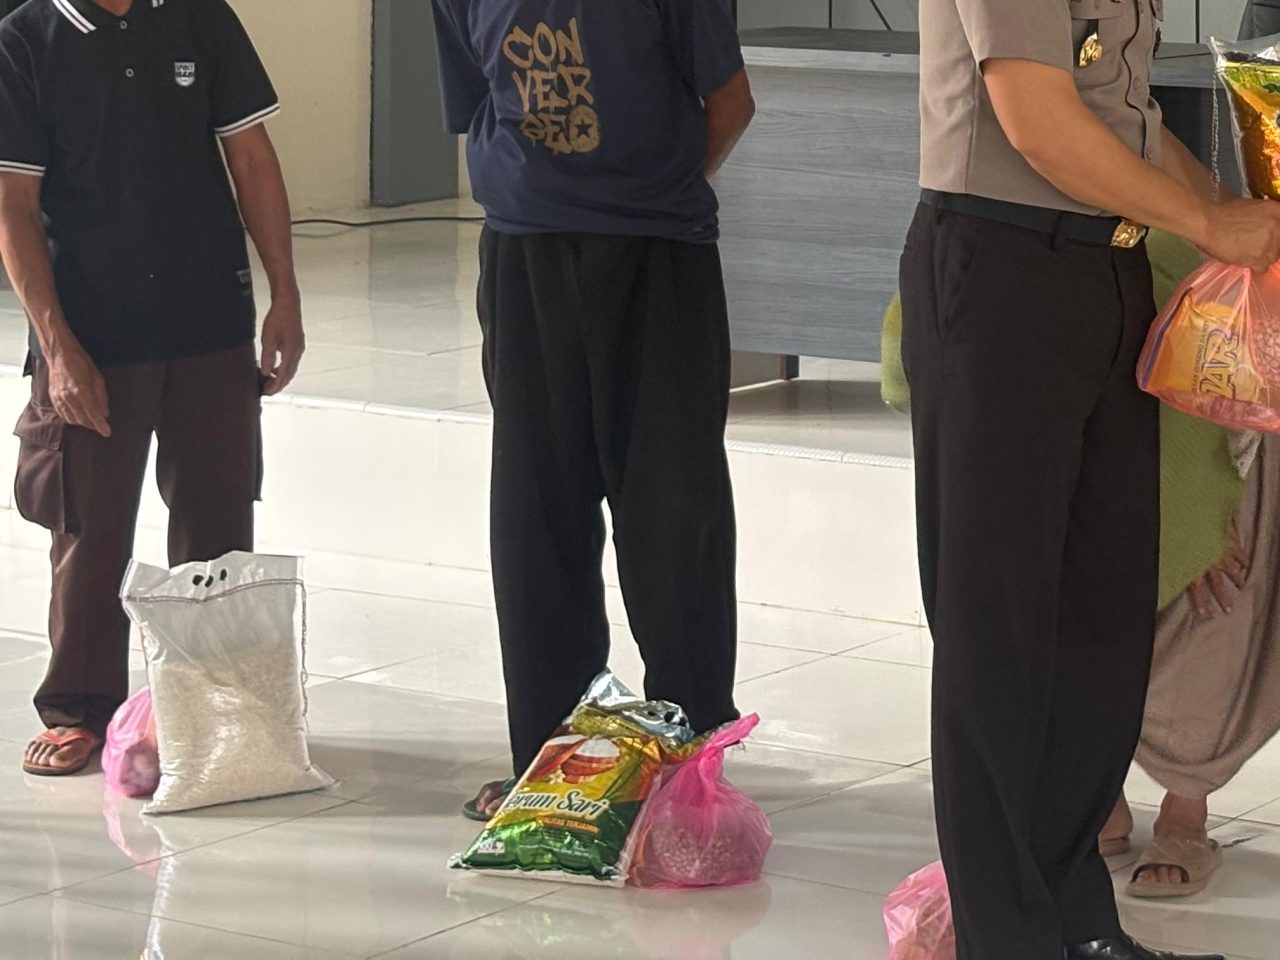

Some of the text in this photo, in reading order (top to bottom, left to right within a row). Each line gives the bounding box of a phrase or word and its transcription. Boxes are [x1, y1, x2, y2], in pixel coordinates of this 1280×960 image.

[503, 17, 584, 70] CON
[512, 64, 594, 113] VER
[557, 790, 608, 816] Sari
